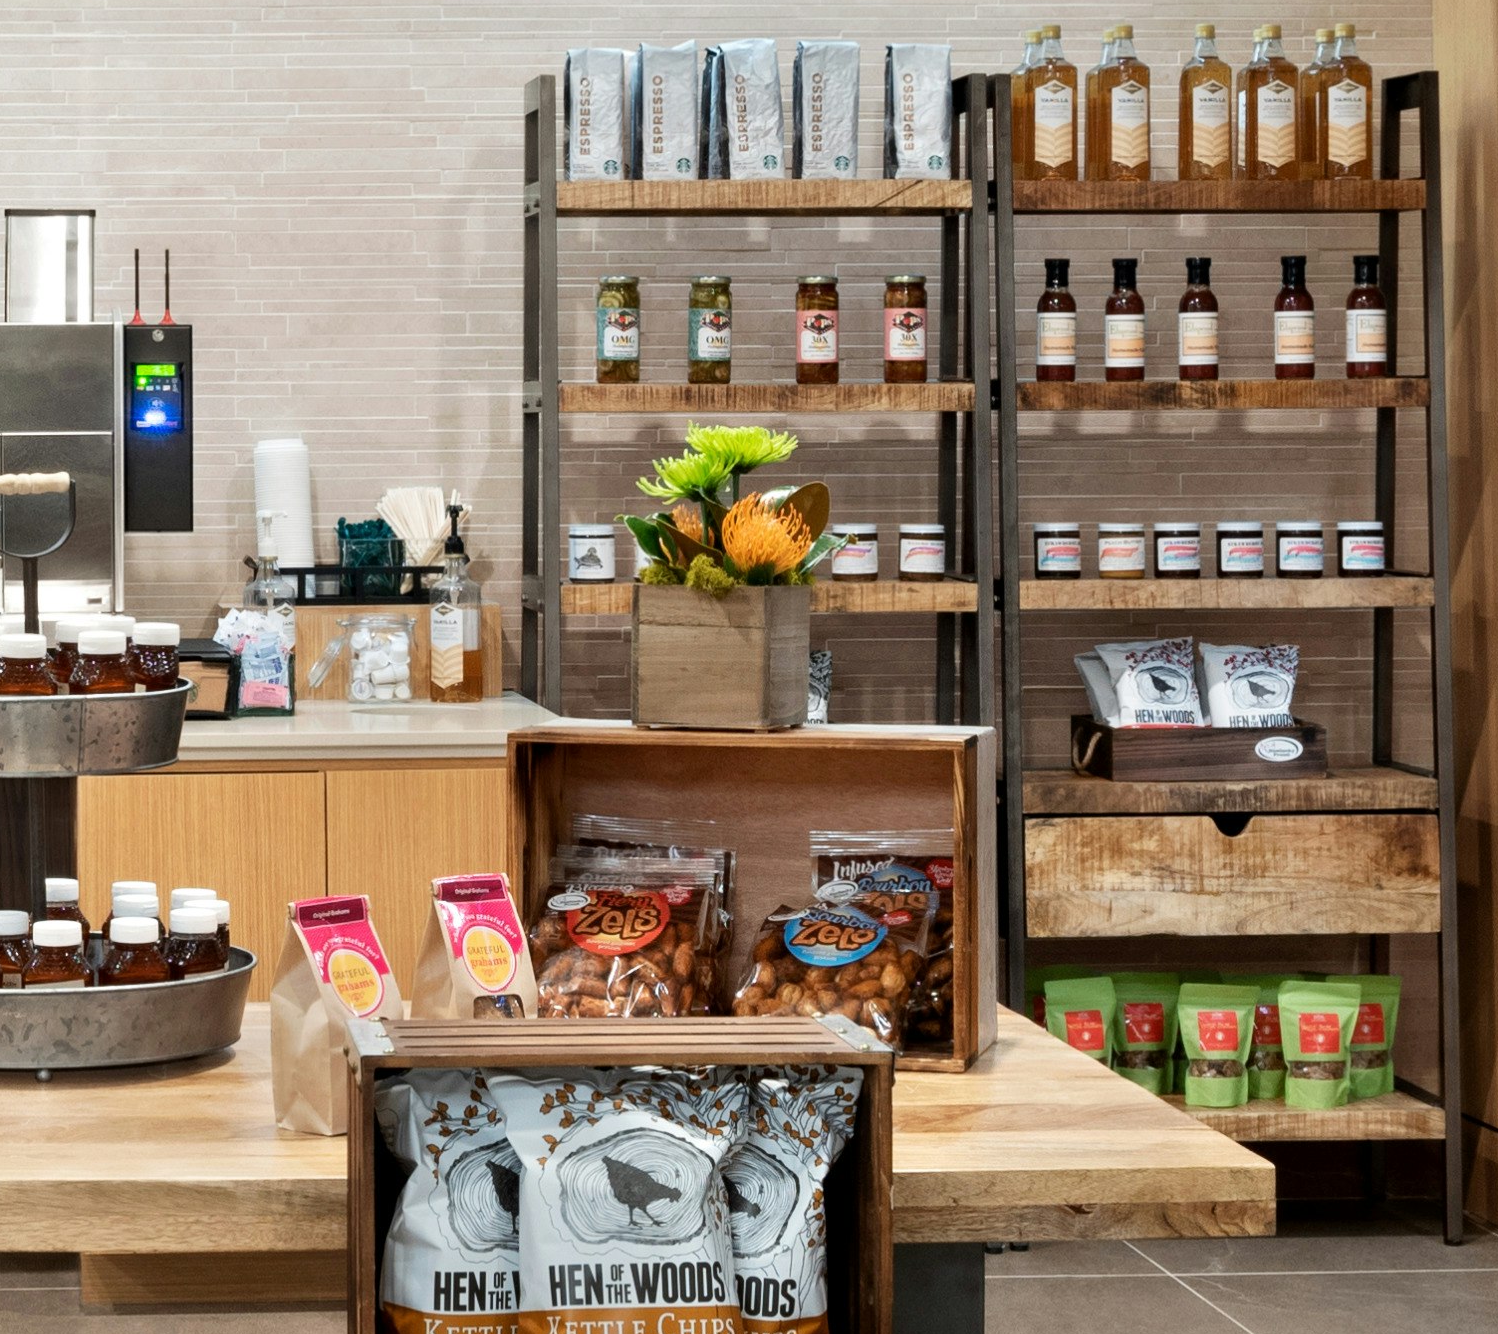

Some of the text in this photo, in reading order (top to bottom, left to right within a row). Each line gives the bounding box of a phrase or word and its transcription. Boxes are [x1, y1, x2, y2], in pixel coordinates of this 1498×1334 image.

[579, 76, 590, 156] ESPRESSO
[653, 75, 664, 154] ESPRESSO
[735, 74, 749, 153] ESPRESSO
[811, 73, 824, 152] ESPRESSO
[903, 73, 914, 151] ESPRESSO
[1135, 709, 1196, 724] HEN WOODS
[833, 857, 894, 882] Infused
[858, 875, 932, 893] Bourbon
[467, 945, 506, 955] GRATEFUL
[470, 957, 509, 970] grahams
[332, 969, 371, 980] GRATEFUL
[434, 1271, 512, 1312] HEN OF THE
[549, 1261, 726, 1307] HEN OF THE WOODS
